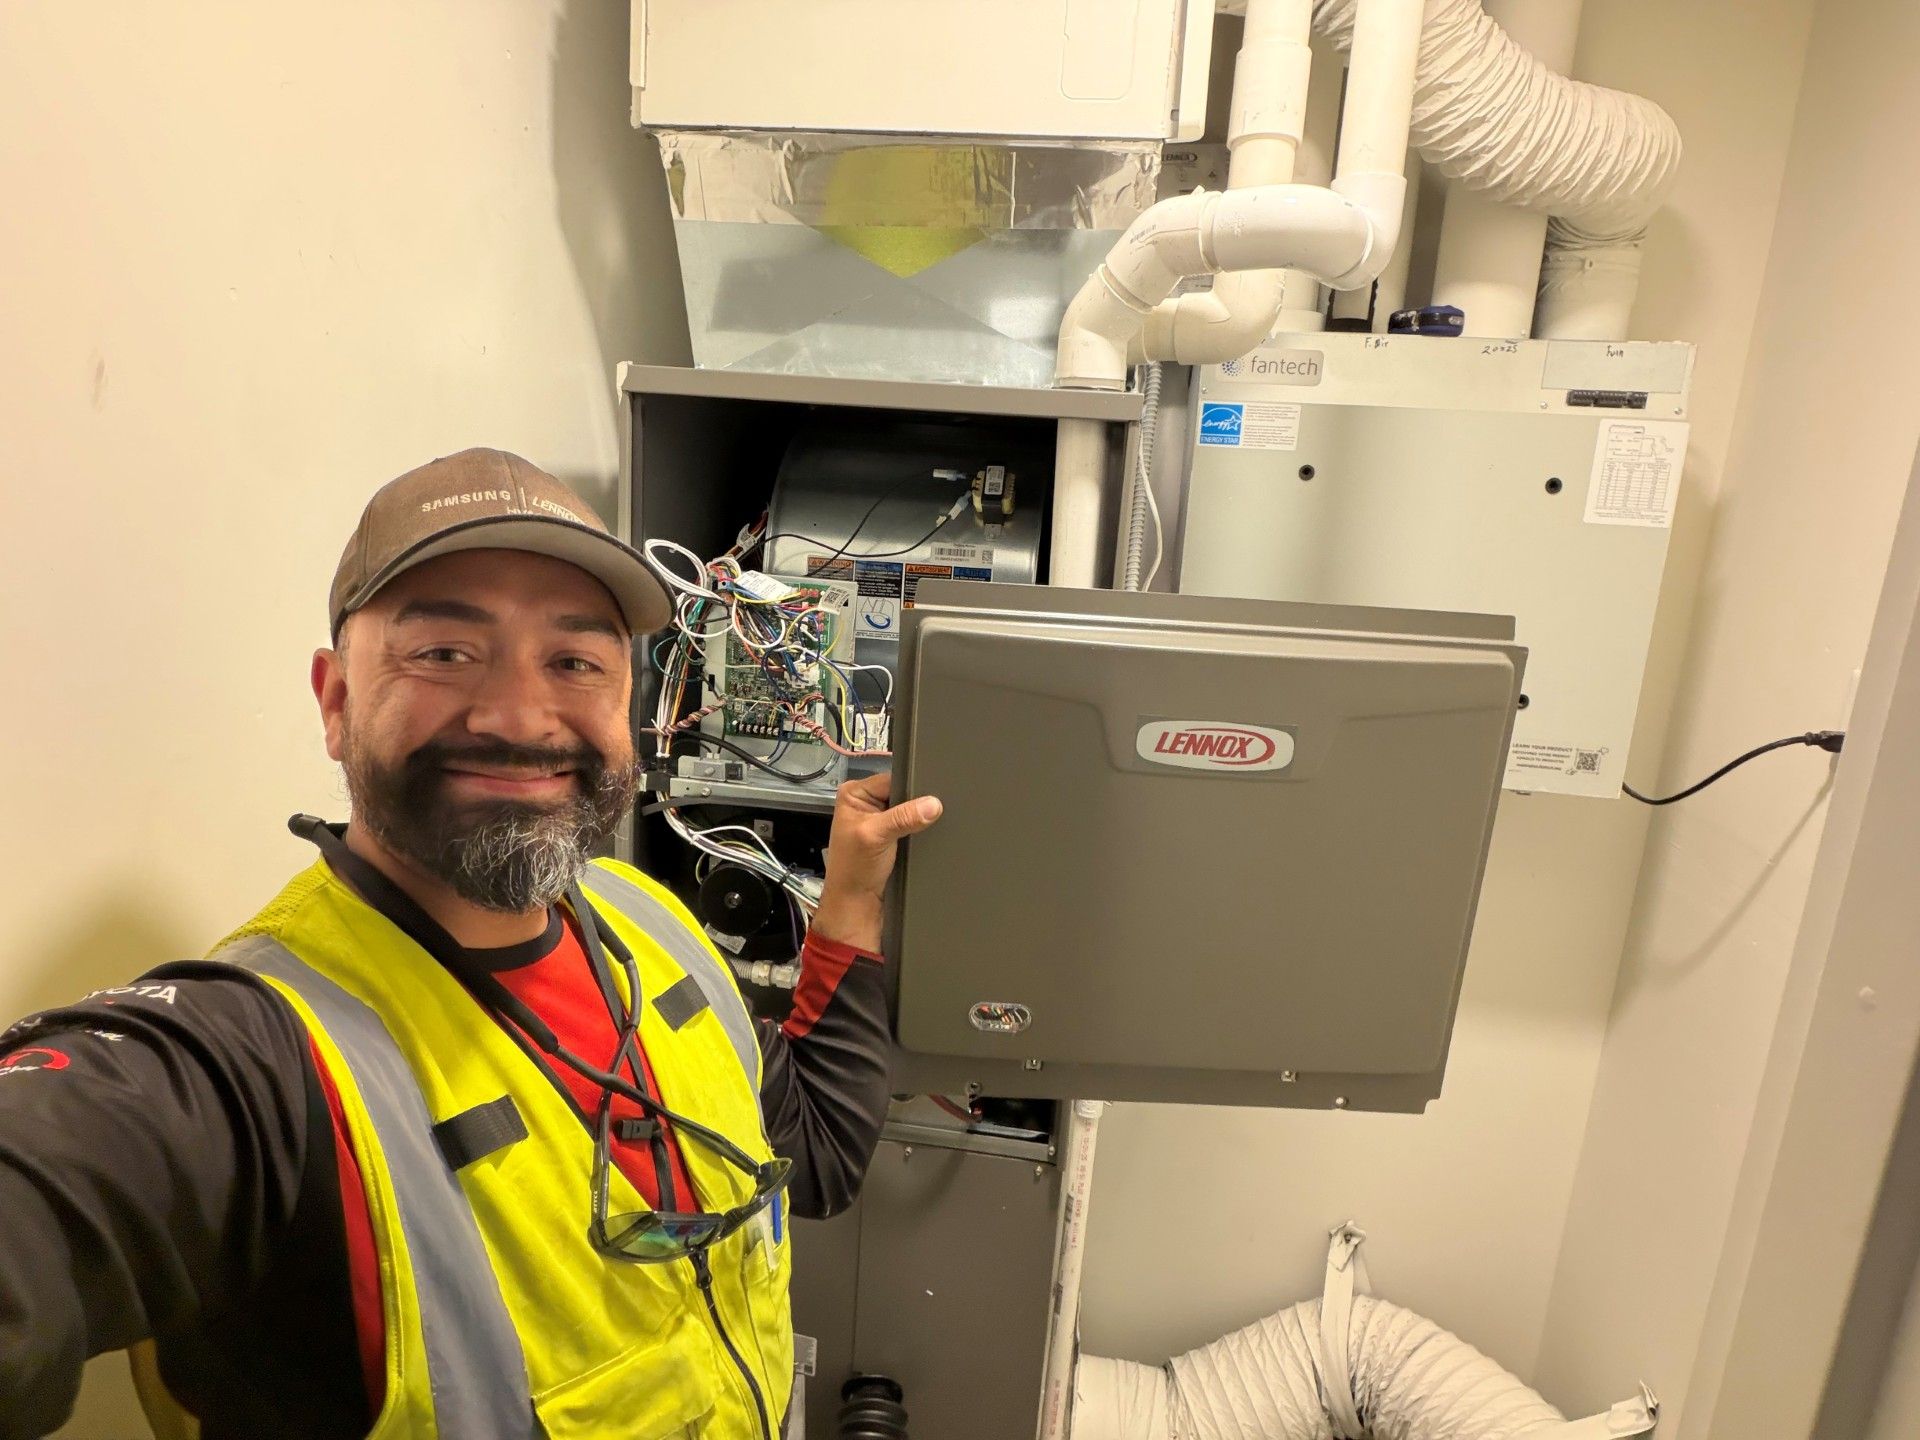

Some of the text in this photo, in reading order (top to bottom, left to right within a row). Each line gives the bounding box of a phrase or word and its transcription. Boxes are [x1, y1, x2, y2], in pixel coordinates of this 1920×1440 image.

[1251, 355, 1318, 376] fantech
[1200, 435, 1239, 444] ENERGY STAR
[421, 489, 511, 513] SAMSUNG
[1154, 731, 1255, 759] LENNOX
